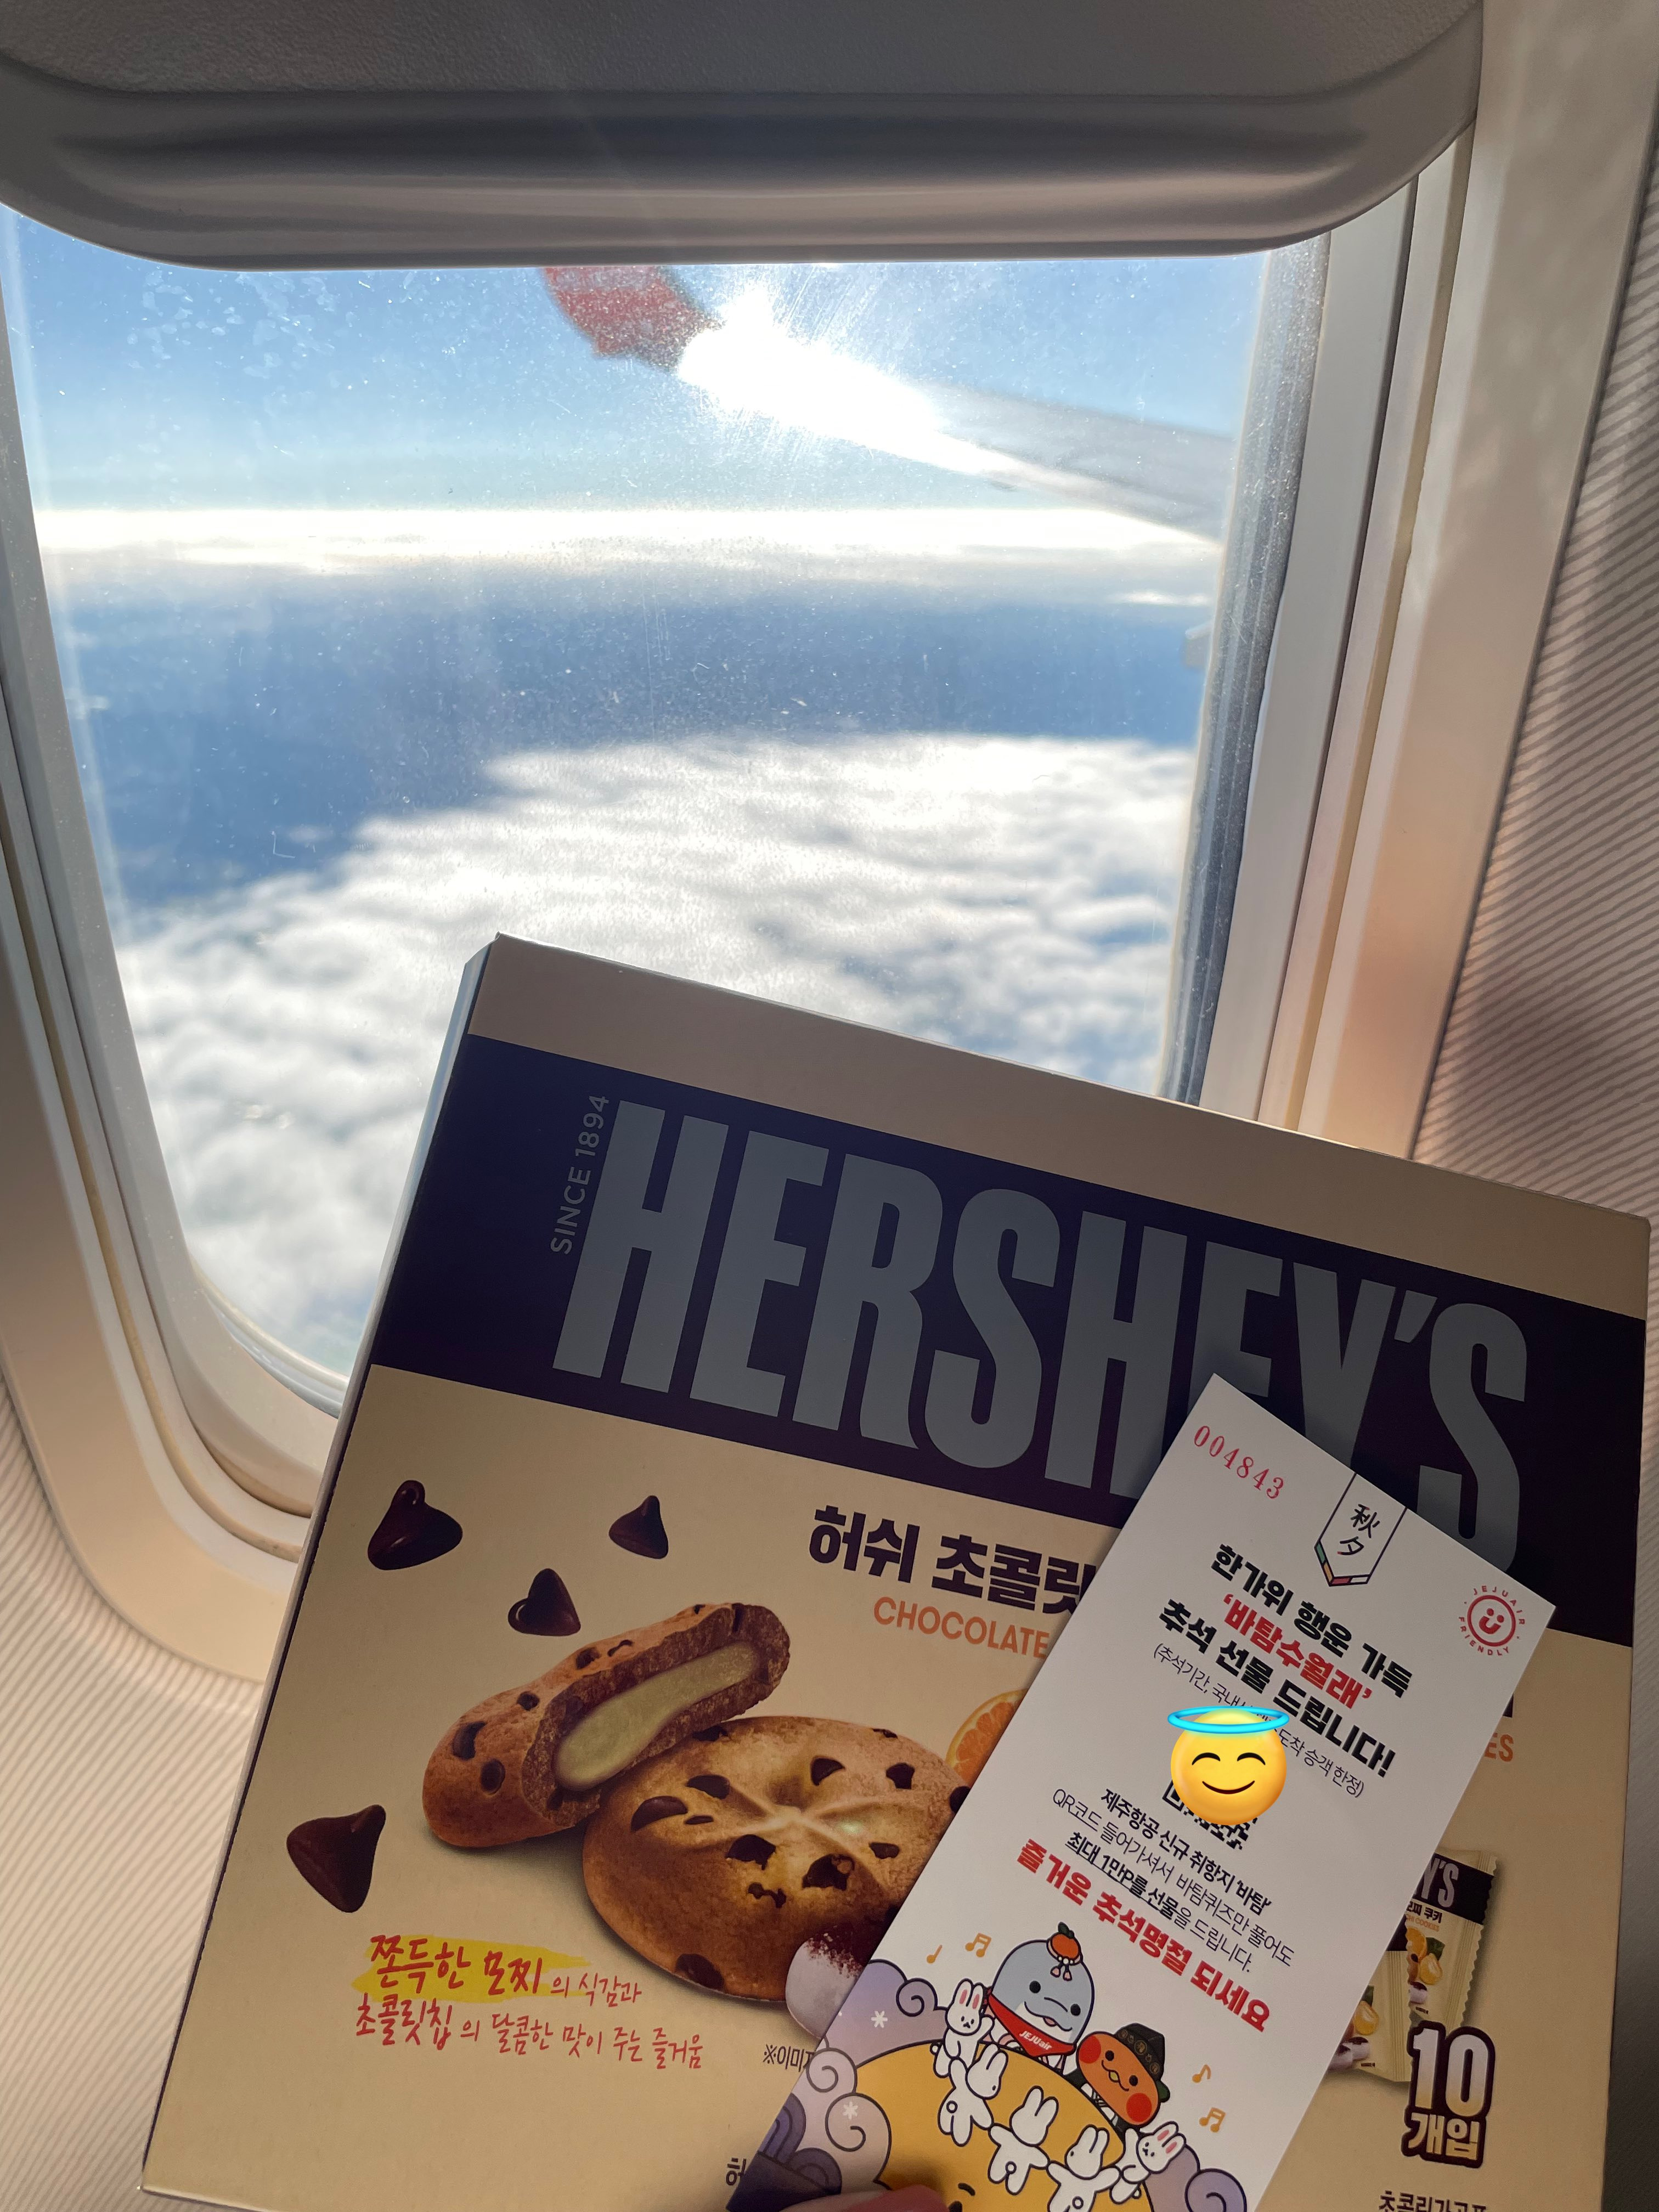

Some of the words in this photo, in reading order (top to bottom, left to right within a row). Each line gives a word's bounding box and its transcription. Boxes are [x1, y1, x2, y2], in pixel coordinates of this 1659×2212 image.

[550, 1166, 591, 1255] SINCE
[575, 1096, 610, 1158] 1894
[552, 1100, 1527, 1572] HERSHEY'S
[1193, 1425, 1284, 1499] 004843
[809, 1505, 921, 1583] 허쉬
[1337, 1504, 1379, 1556] 秋夕
[874, 1596, 1049, 1660] CHOCOLATE
[1210, 1543, 1294, 1616] 한가위
[1294, 1600, 1352, 1658] 행운
[1361, 1643, 1413, 1699] 가득
[1459, 1616, 1510, 1656] FRIENDLY
[1473, 1585, 1525, 1625] JEJUAIR
[1153, 1643, 1211, 1694] (추석기간,
[1304, 1748, 1333, 1778] 승객
[1331, 1765, 1365, 1798] 한정)
[1158, 1599, 1217, 1654] 추석
[1215, 1640, 1274, 1695] 선물
[1272, 1679, 1396, 1778] 드립니다!
[1052, 1788, 1102, 1827] QR코드
[1099, 1821, 1175, 1883] 들어가셔서
[1176, 1873, 1250, 1937] 바탐퀴즈만
[1249, 1923, 1295, 1967] 풀어도
[1100, 1788, 1160, 1840] 제주항공
[1159, 1830, 1190, 1861] 신규
[1189, 1850, 1236, 1893] 취항지
[1017, 1838, 1092, 1906] 즐거운
[1092, 1891, 1193, 1976] 추석명절
[1189, 1960, 1271, 2033] 되세요
[1066, 1831, 1101, 1865] 최대
[1101, 1854, 1149, 1897] 1만P를
[1147, 1887, 1193, 1931] 선물을
[1189, 1918, 1251, 1973] 드립니다.
[370, 1934, 471, 1995] 쫀득한
[483, 1949, 543, 1995] 모찌
[550, 1975, 569, 1999] 의
[578, 1972, 642, 2007] 식감과
[355, 1992, 453, 2051] 초콜릿칩
[460, 2019, 481, 2041] 의
[492, 2012, 554, 2056] 달콤한
[562, 2023, 602, 2058] 맛이
[613, 2026, 643, 2062] 주는
[651, 2027, 704, 2070] 즐거움
[1019, 2030, 1053, 2050] JEJUair
[1410, 2025, 1492, 2120] 10
[1407, 2111, 1482, 2163] 개입
